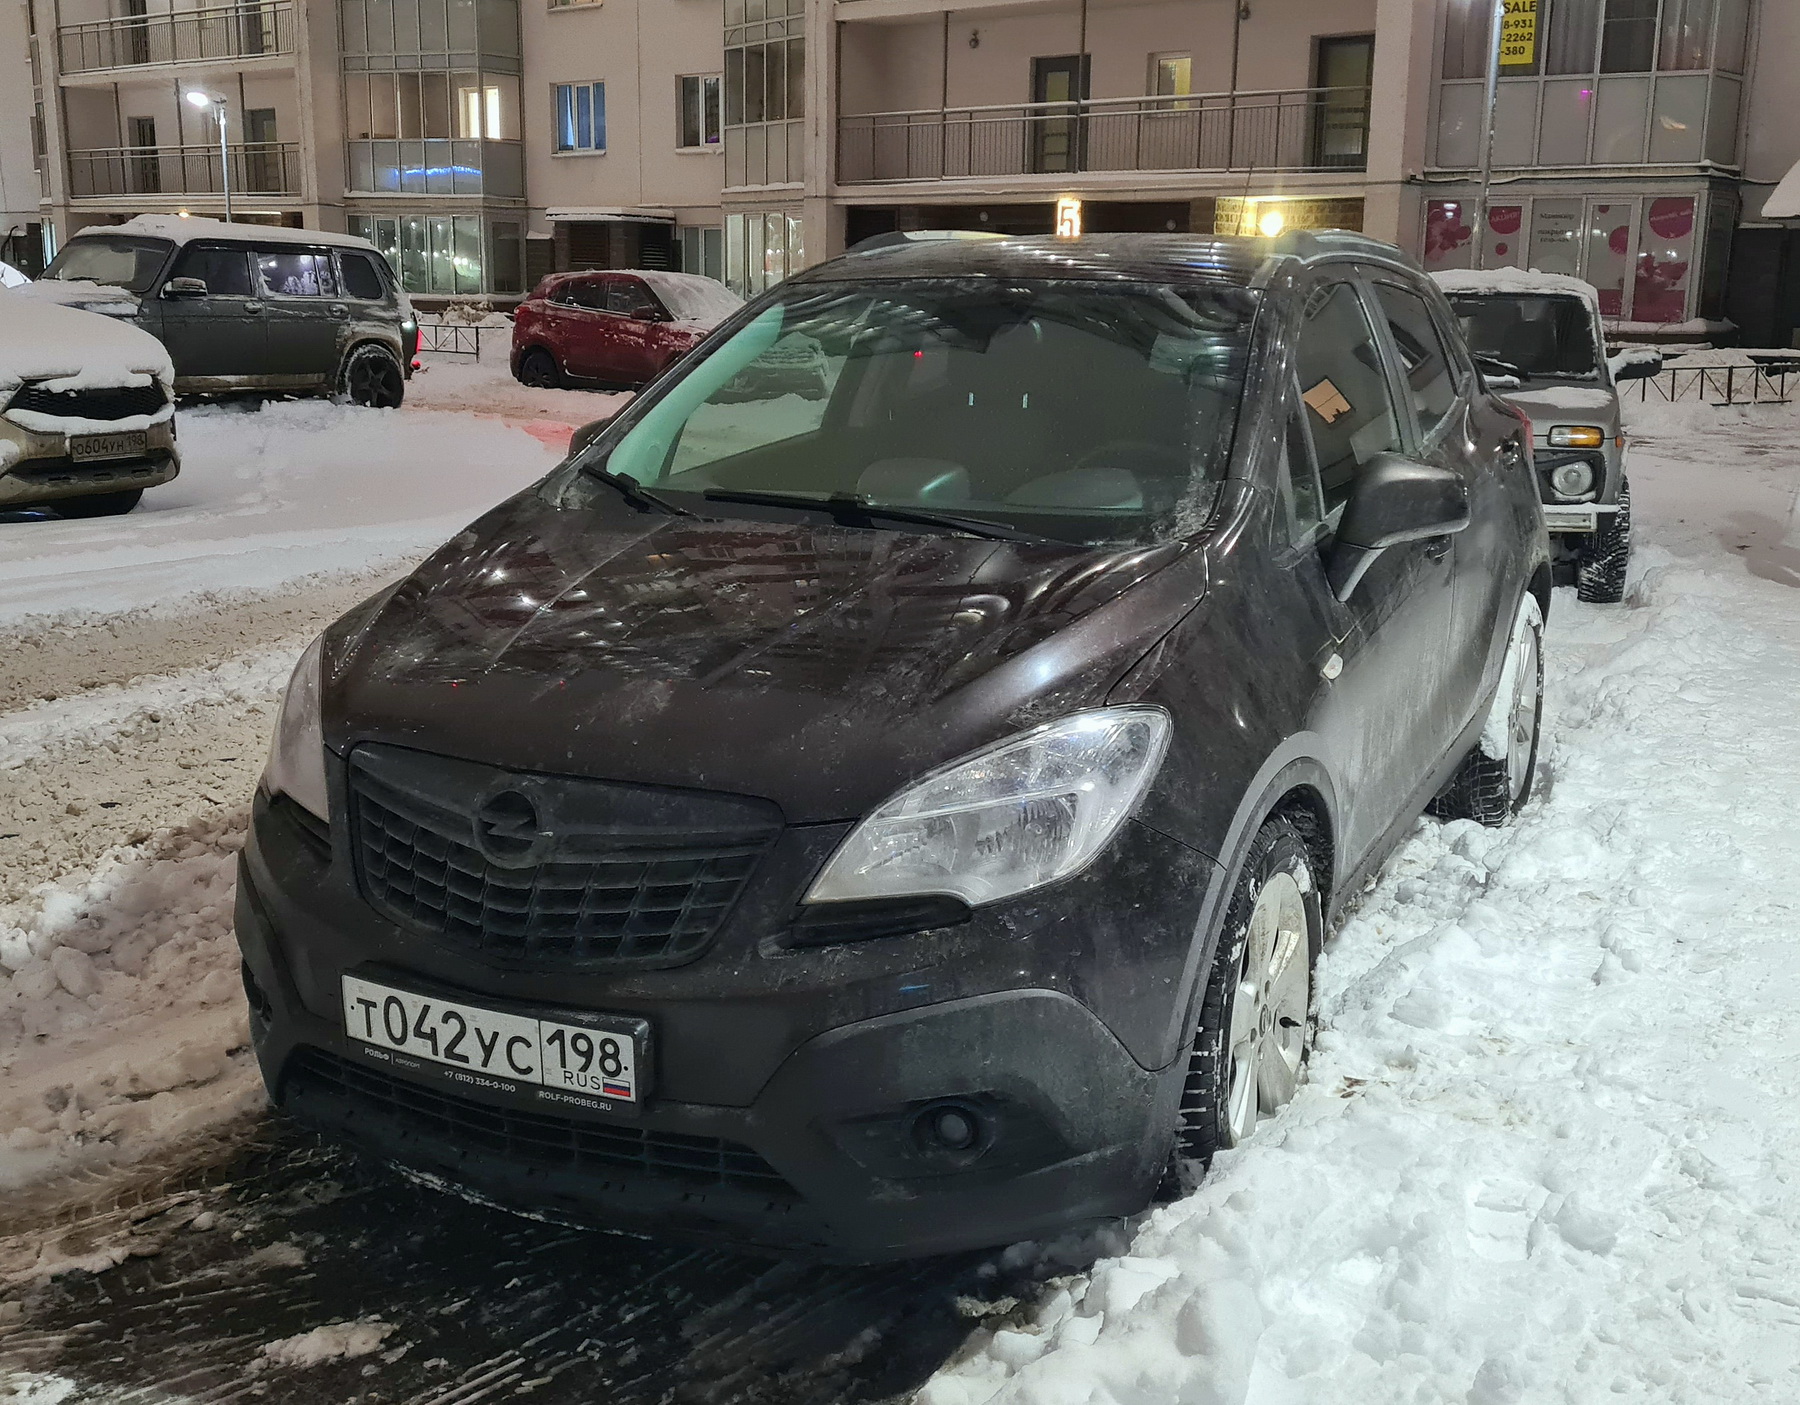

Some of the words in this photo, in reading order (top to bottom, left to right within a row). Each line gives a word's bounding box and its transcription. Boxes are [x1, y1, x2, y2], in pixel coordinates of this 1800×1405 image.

[1503, 1, 1537, 14] SALE
[1504, 19, 1533, 29] 8-931
[356, 995, 533, 1076] Т042УС
[546, 1029, 622, 1077] 198
[455, 1072, 474, 1085] (812)
[475, 1077, 516, 1093] 334-0-100
[563, 1070, 600, 1091] RUS
[538, 1090, 612, 1111] ROLF-PROBEG.RU
